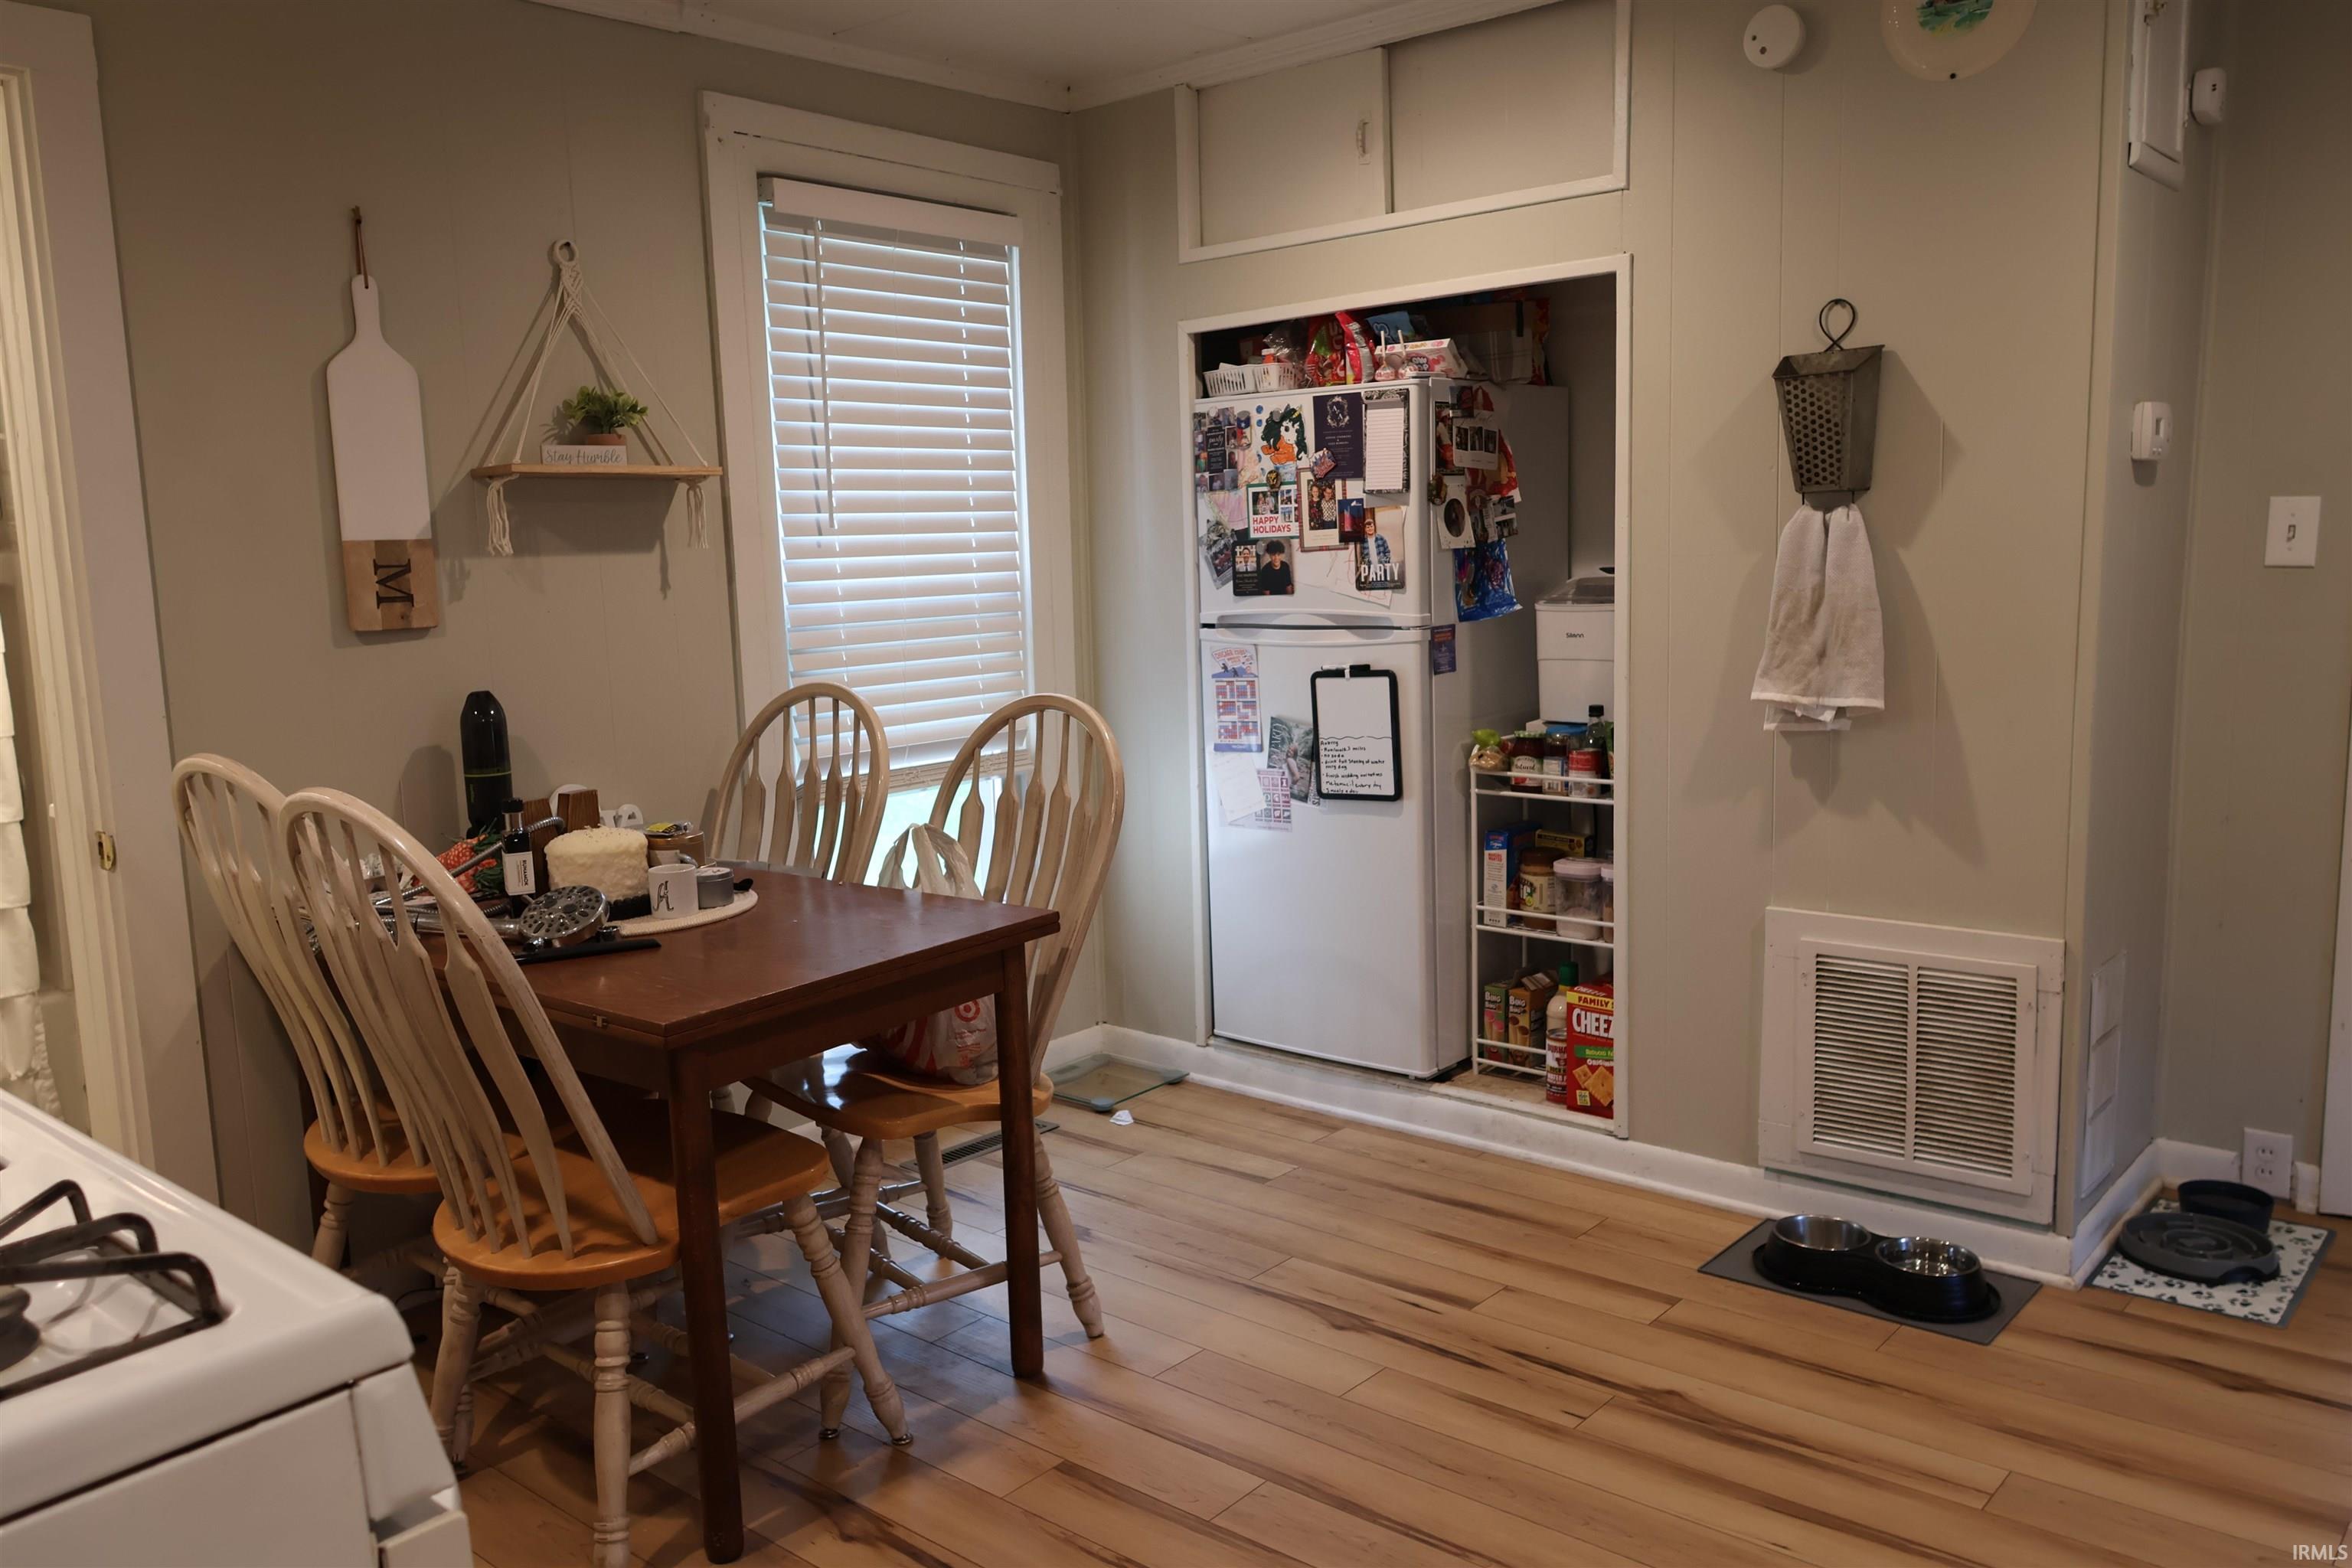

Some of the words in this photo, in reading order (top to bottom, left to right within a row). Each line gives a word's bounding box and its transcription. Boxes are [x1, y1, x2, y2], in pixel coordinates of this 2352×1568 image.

[545, 449, 572, 465] Stay
[576, 449, 622, 465] Humble
[1252, 516, 1279, 525] HAPPY
[1253, 524, 1292, 534] HOLIDAYS
[1361, 563, 1400, 583] PARTY
[372, 557, 415, 609] M
[1577, 995, 1610, 1008] FAMILY
